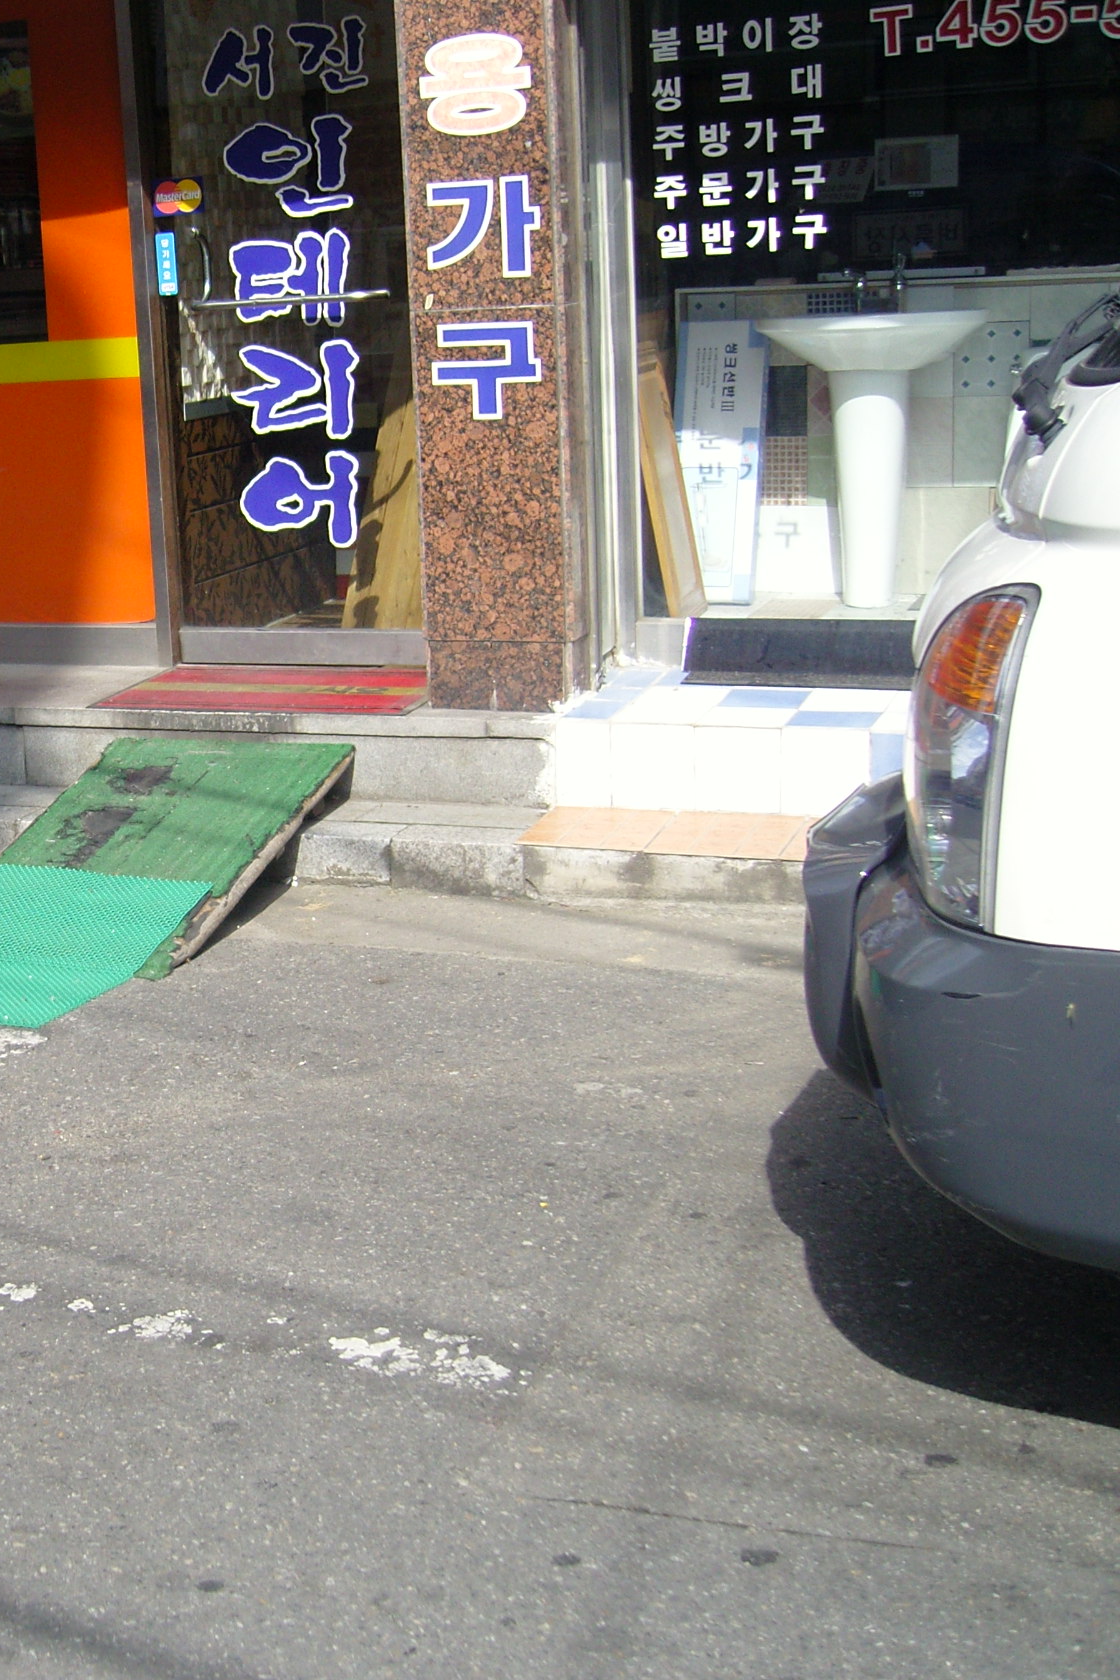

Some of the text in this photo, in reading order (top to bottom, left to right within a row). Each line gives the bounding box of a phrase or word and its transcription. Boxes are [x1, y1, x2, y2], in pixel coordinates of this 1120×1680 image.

[652, 114, 825, 161] 주방가구
[155, 190, 200, 203] MasterCard
[653, 164, 826, 210] 주문가구
[656, 214, 828, 260] 일반가구
[224, 113, 360, 548] 인테리어
